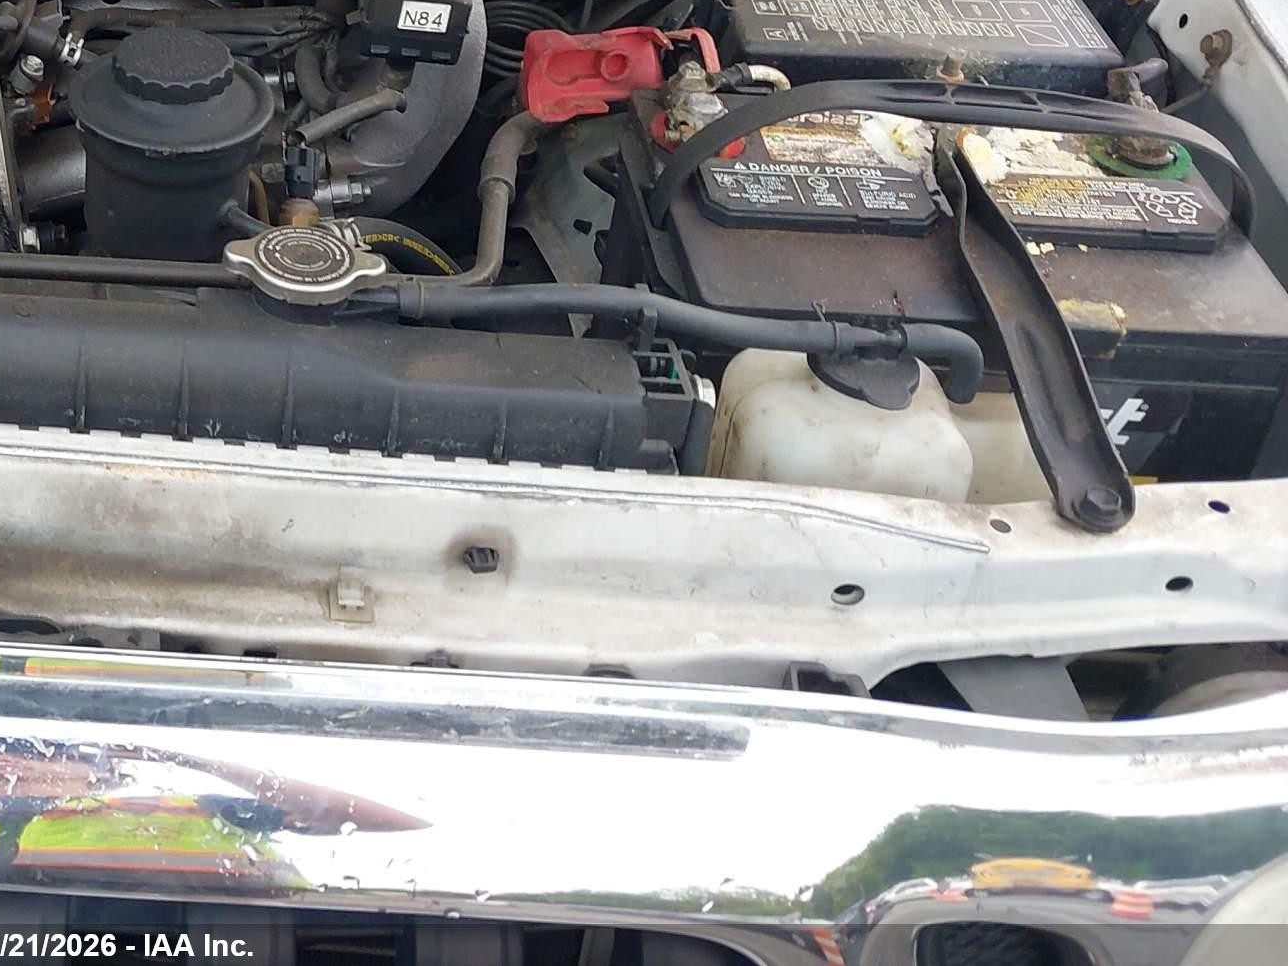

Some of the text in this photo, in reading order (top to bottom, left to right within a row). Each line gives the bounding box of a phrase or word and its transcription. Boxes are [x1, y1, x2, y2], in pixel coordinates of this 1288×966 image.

[403, 10, 443, 27] N84
[748, 162, 883, 177] DANGER / POISON
